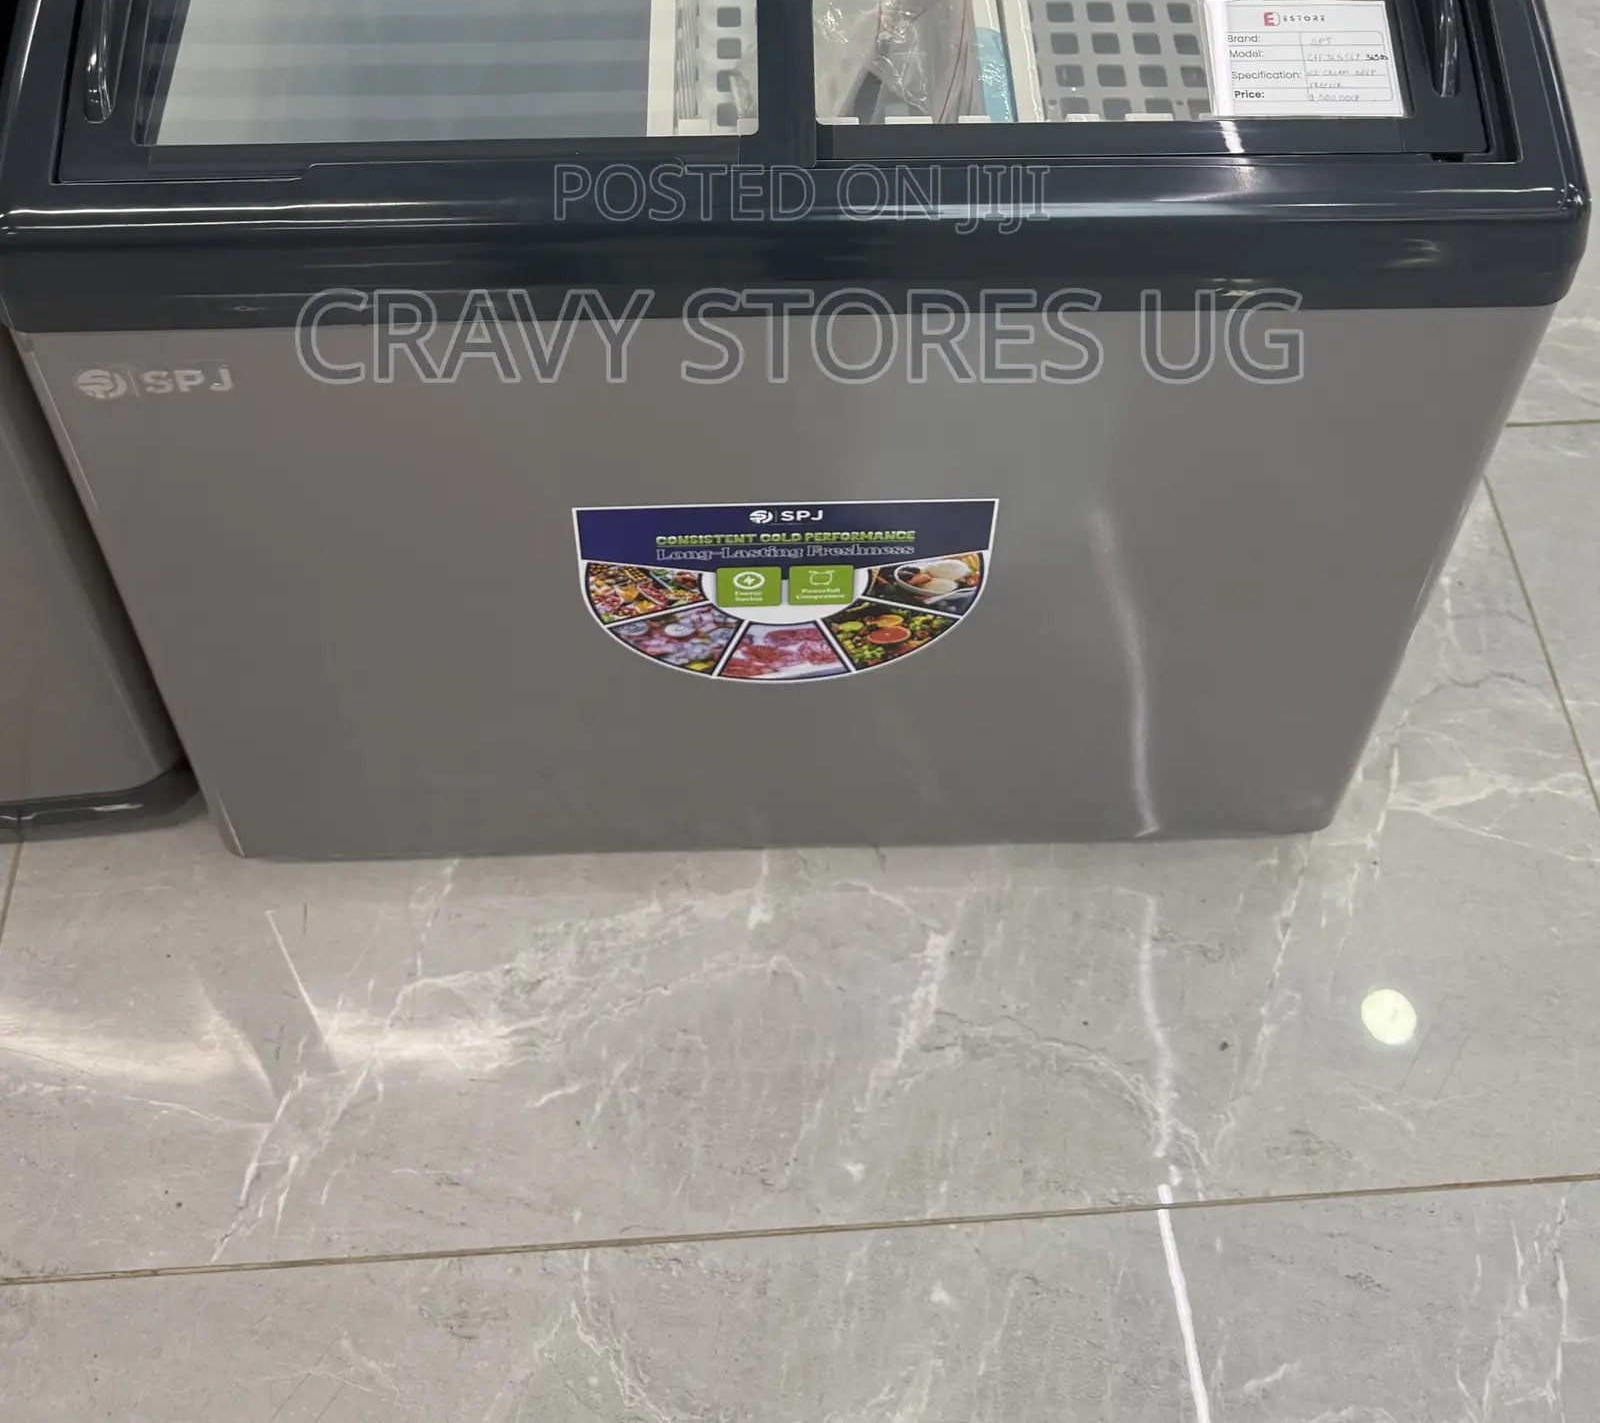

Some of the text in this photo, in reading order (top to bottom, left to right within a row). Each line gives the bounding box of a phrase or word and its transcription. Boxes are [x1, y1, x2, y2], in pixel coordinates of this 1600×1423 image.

[1283, 14, 1325, 22] ESTORE
[1227, 34, 1261, 43] Brand:
[1229, 49, 1264, 58] Model:
[1231, 70, 1303, 81] Specification:
[1234, 89, 1264, 99] Price:
[143, 367, 234, 393] SPJ
[780, 509, 823, 522] SPJ
[656, 530, 916, 546] CONSISTENT COLD PERFORMANCE
[656, 544, 915, 561] Long-Lasting Freshness
